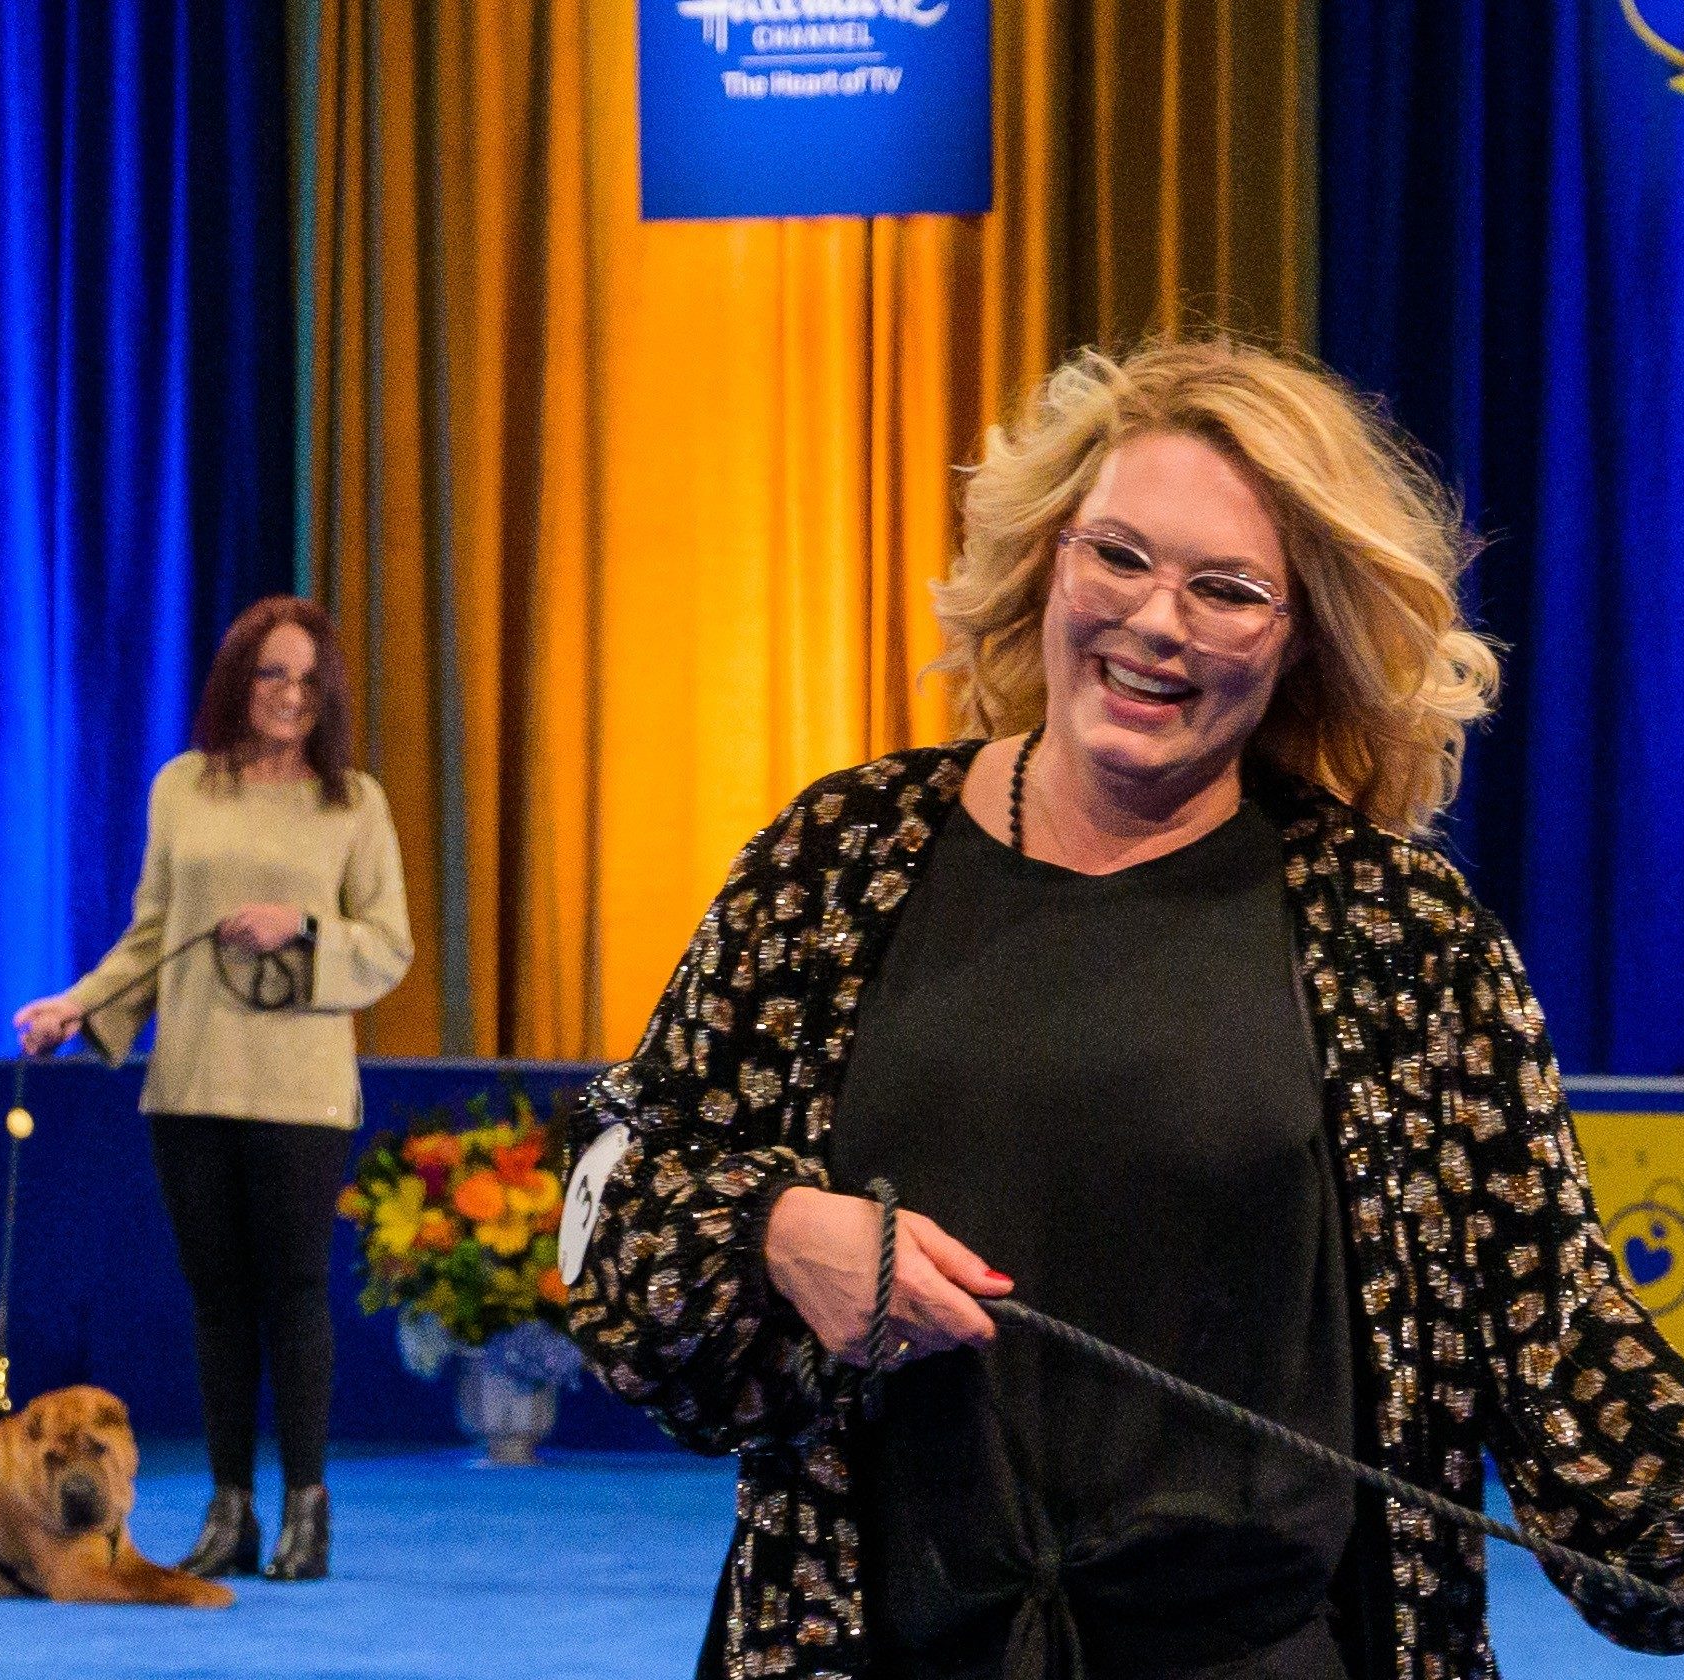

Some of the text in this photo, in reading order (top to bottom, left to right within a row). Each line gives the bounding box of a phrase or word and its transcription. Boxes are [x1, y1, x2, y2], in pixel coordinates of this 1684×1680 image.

[751, 22, 874, 51] CHANNEL
[721, 66, 904, 99] The Heart of TV
